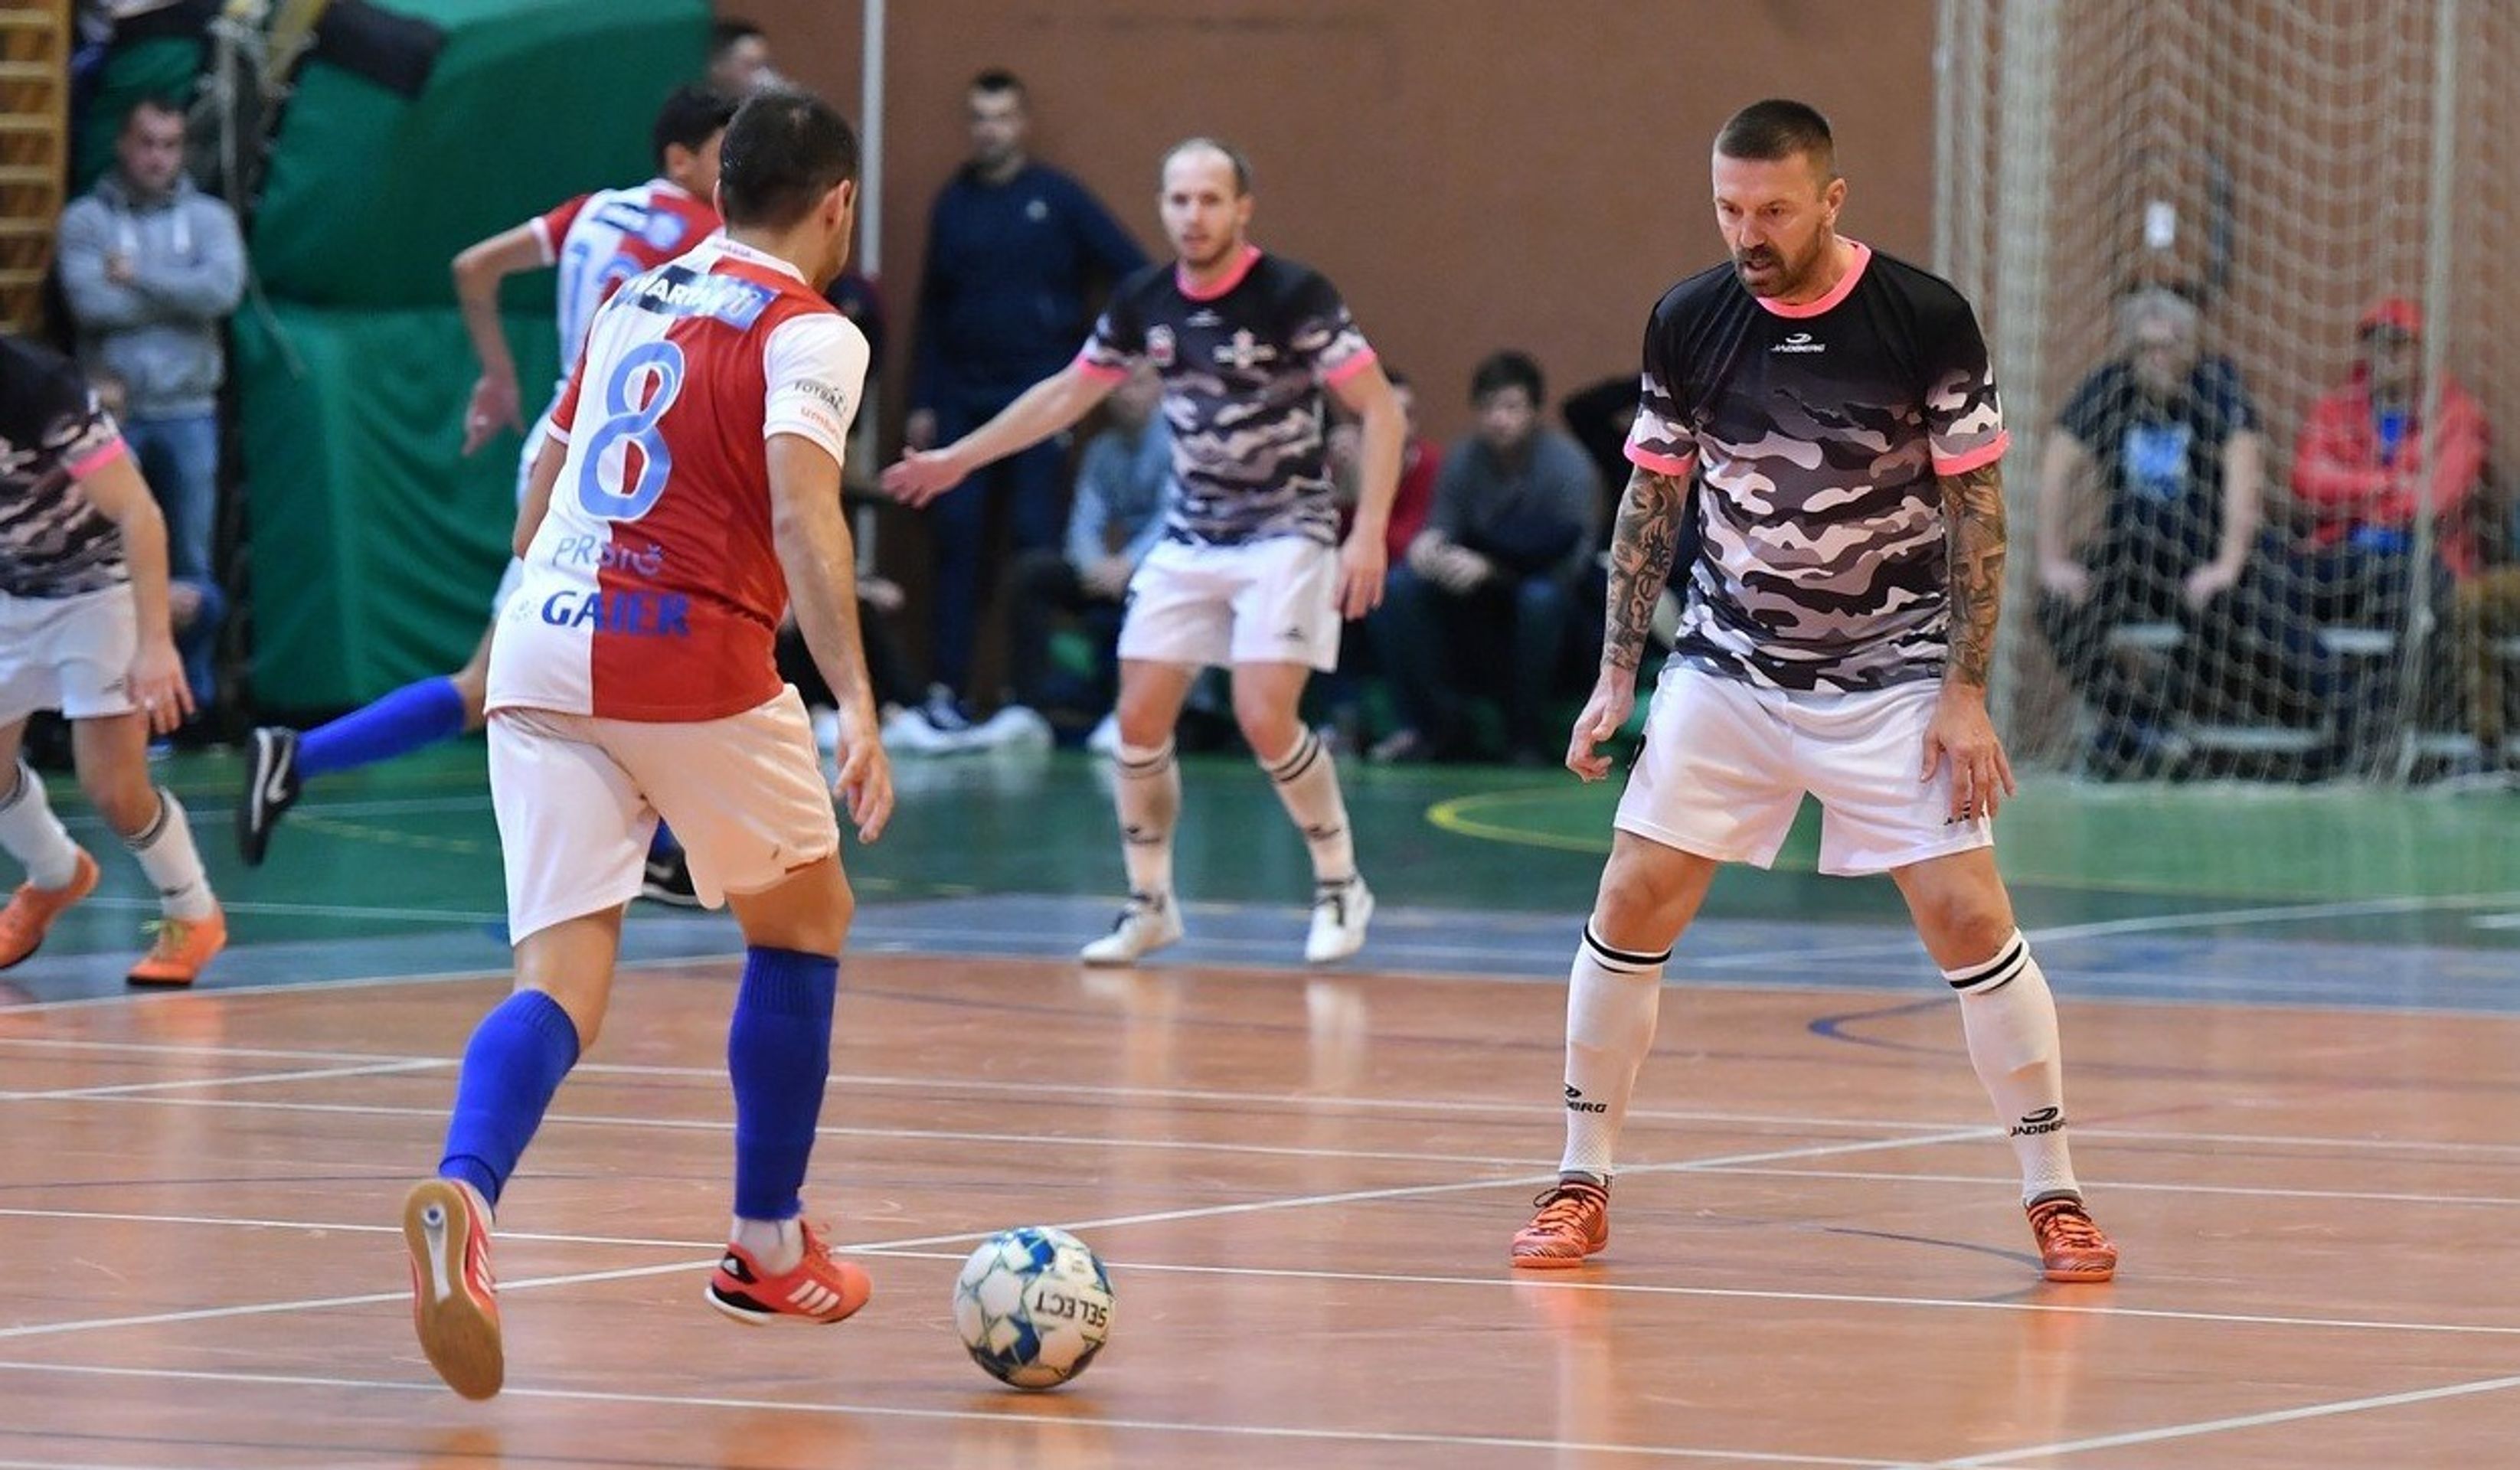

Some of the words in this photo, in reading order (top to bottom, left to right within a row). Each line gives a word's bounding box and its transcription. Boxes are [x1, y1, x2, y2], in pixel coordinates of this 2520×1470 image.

[578, 341, 685, 521] 8
[541, 590, 689, 636] GAIER
[1035, 1291, 1107, 1328] SELECT
